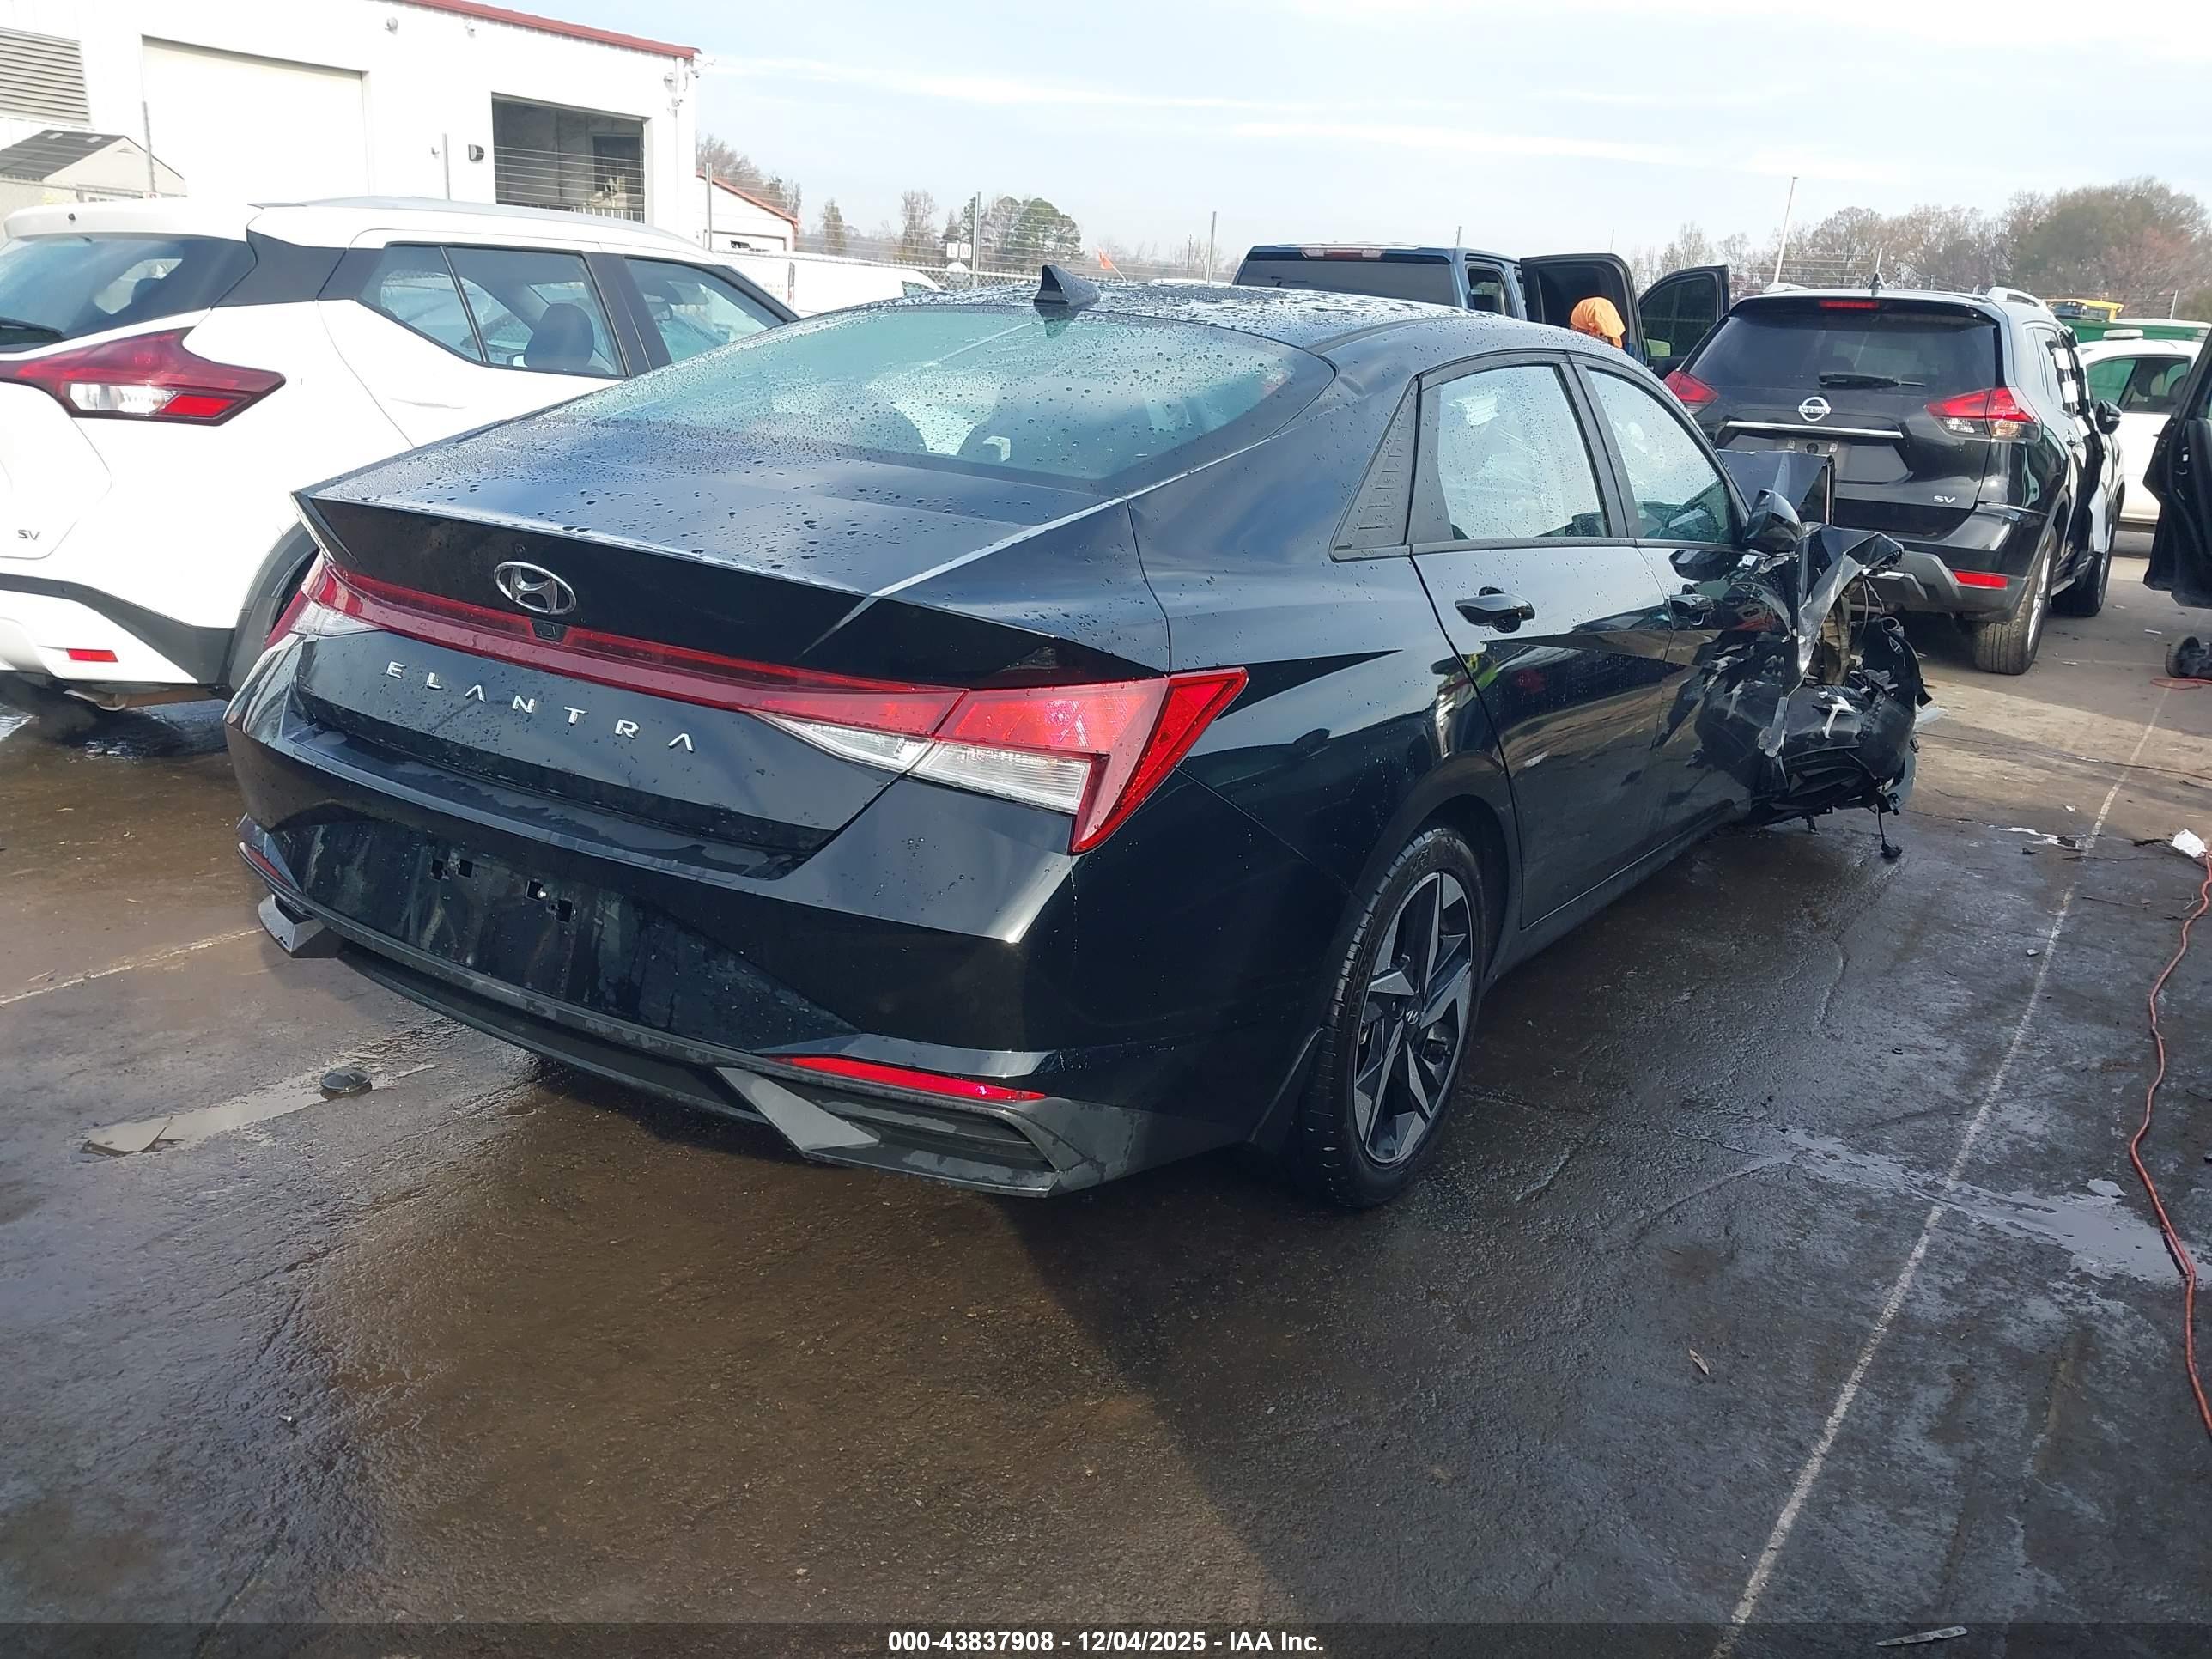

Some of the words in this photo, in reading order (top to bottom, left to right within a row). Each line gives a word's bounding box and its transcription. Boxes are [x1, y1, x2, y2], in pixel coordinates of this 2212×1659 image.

[1933, 495, 1956, 504] SV
[17, 529, 40, 540] SV
[386, 660, 695, 753] ELANTRA
